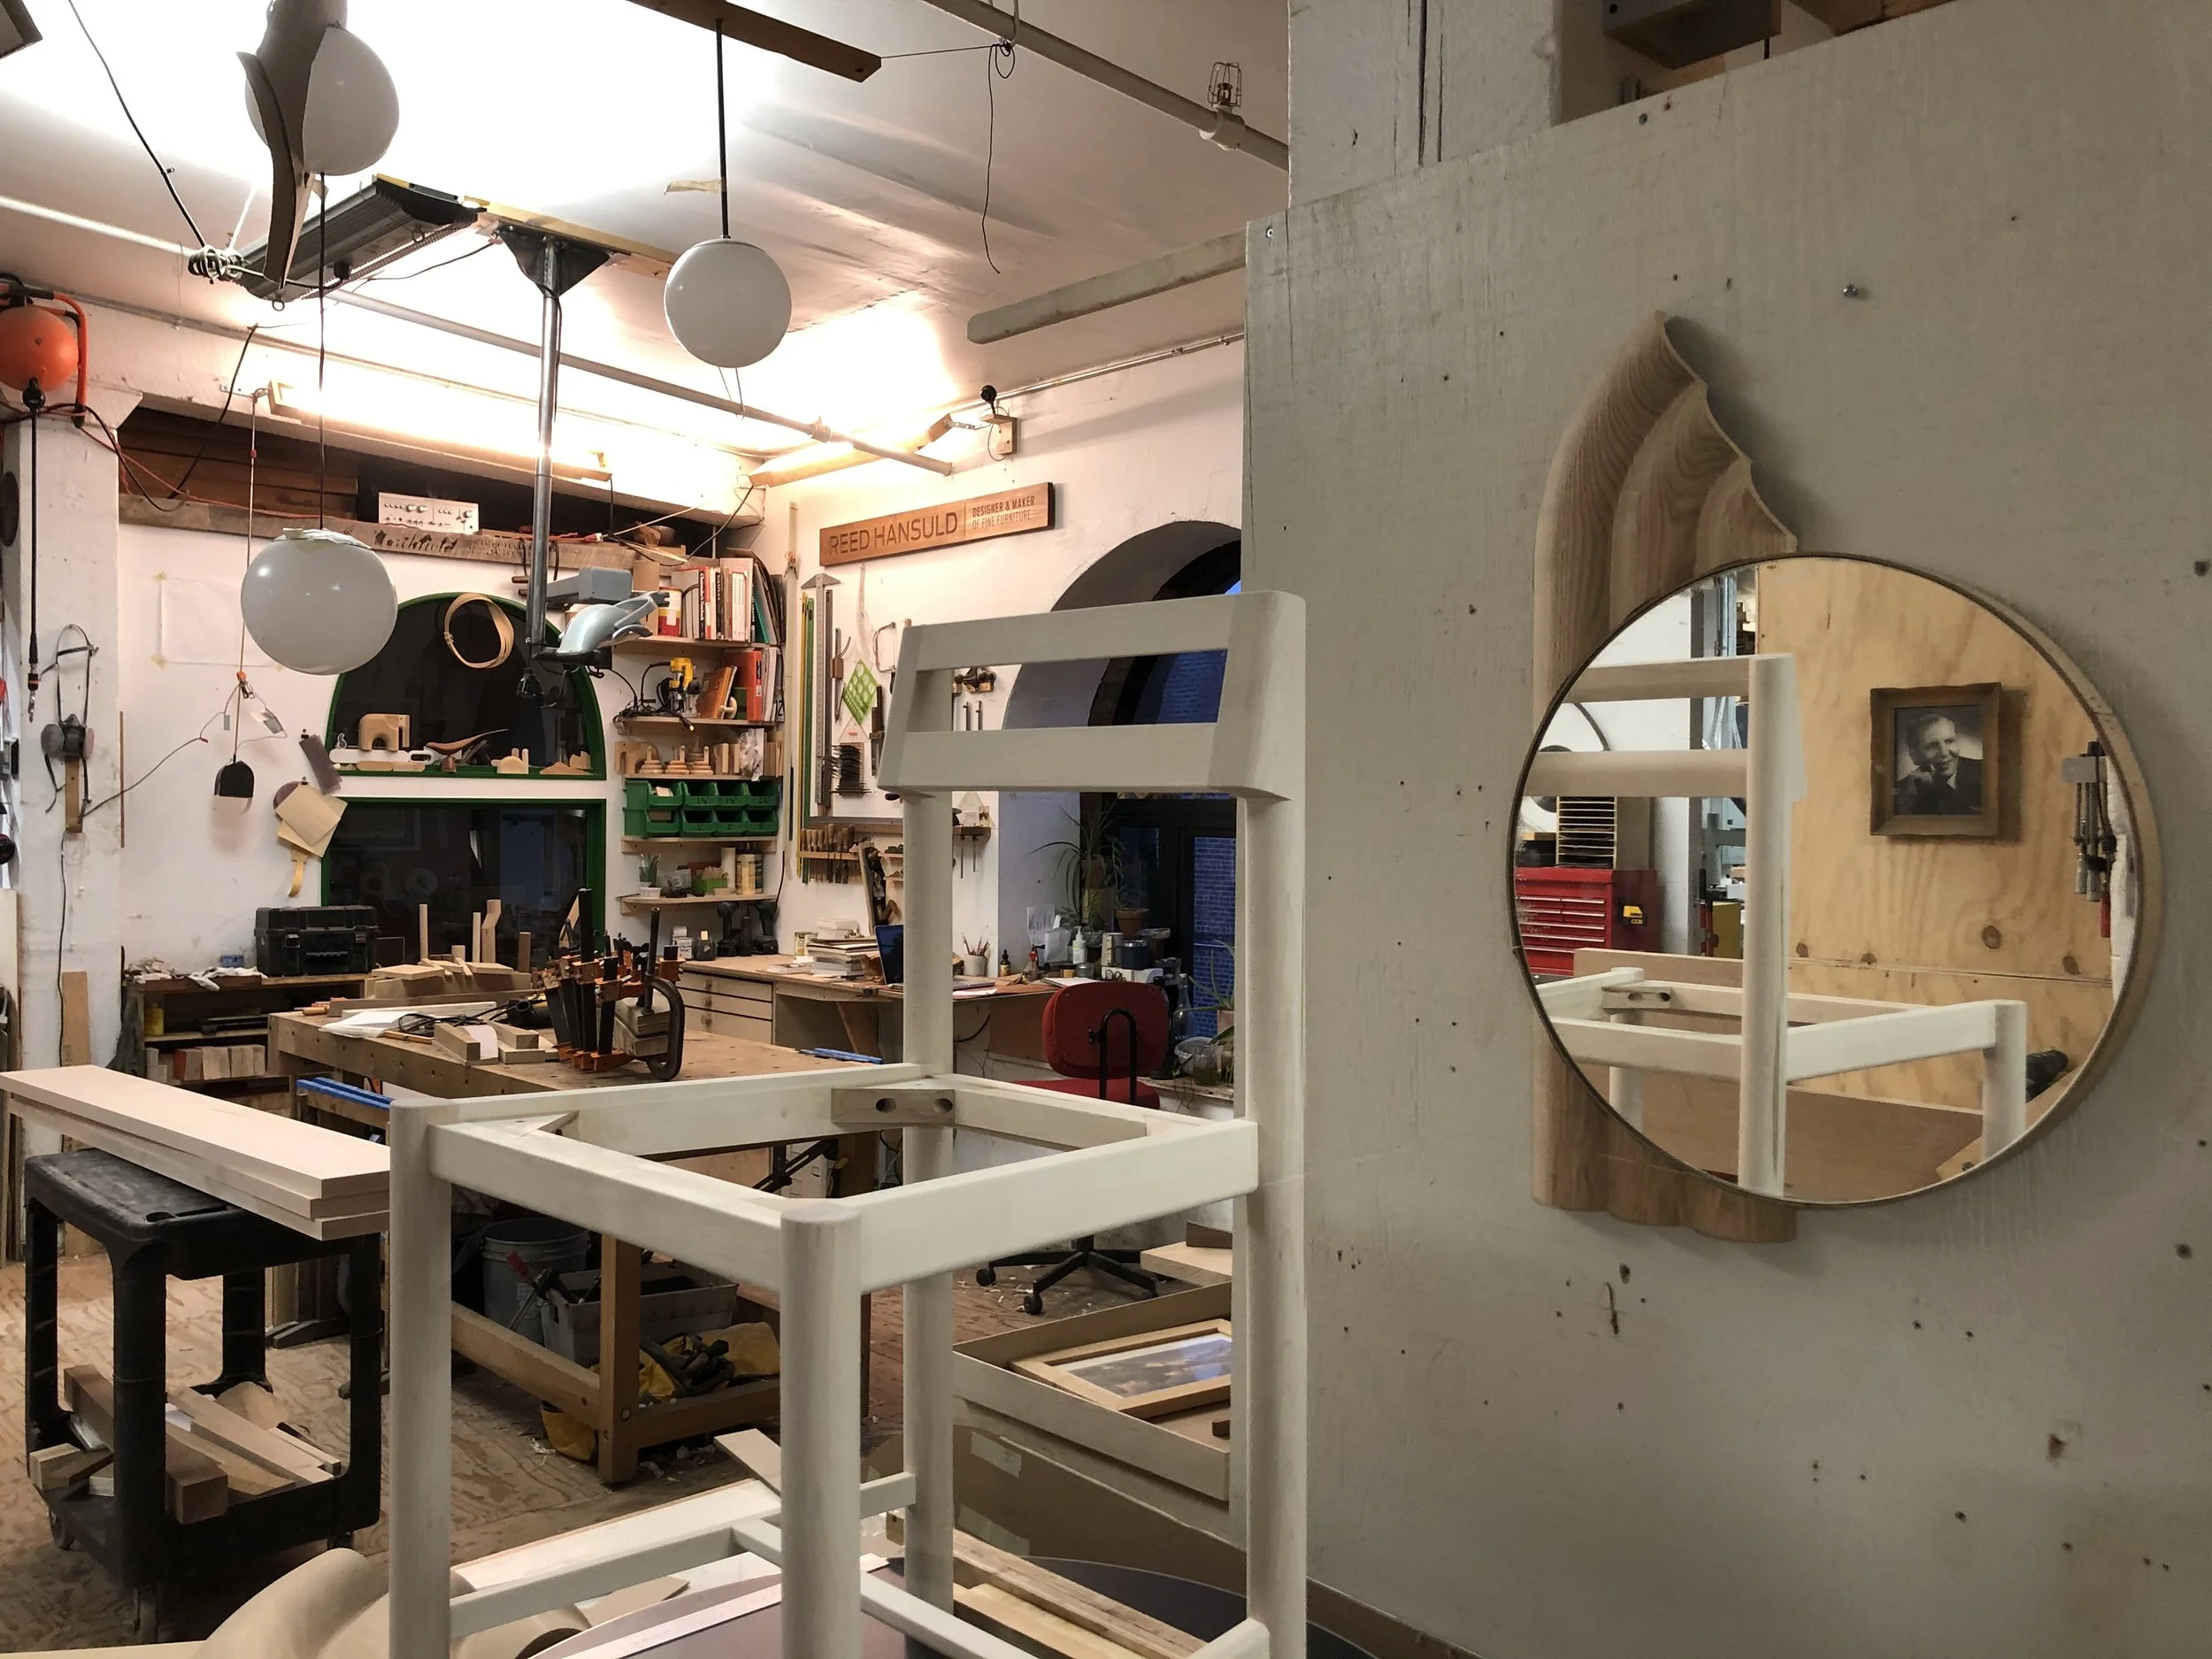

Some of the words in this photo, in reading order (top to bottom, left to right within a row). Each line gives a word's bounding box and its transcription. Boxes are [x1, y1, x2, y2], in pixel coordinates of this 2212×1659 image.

[972, 502, 1003, 518] DESIGNER
[1005, 501, 1010, 511] &
[1011, 495, 1035, 509] MAKER
[972, 519, 981, 530] OF
[981, 516, 995, 529] FINE
[996, 510, 1032, 525] FURNITURE
[829, 529, 870, 557] REED
[874, 511, 958, 549] HANSULD
